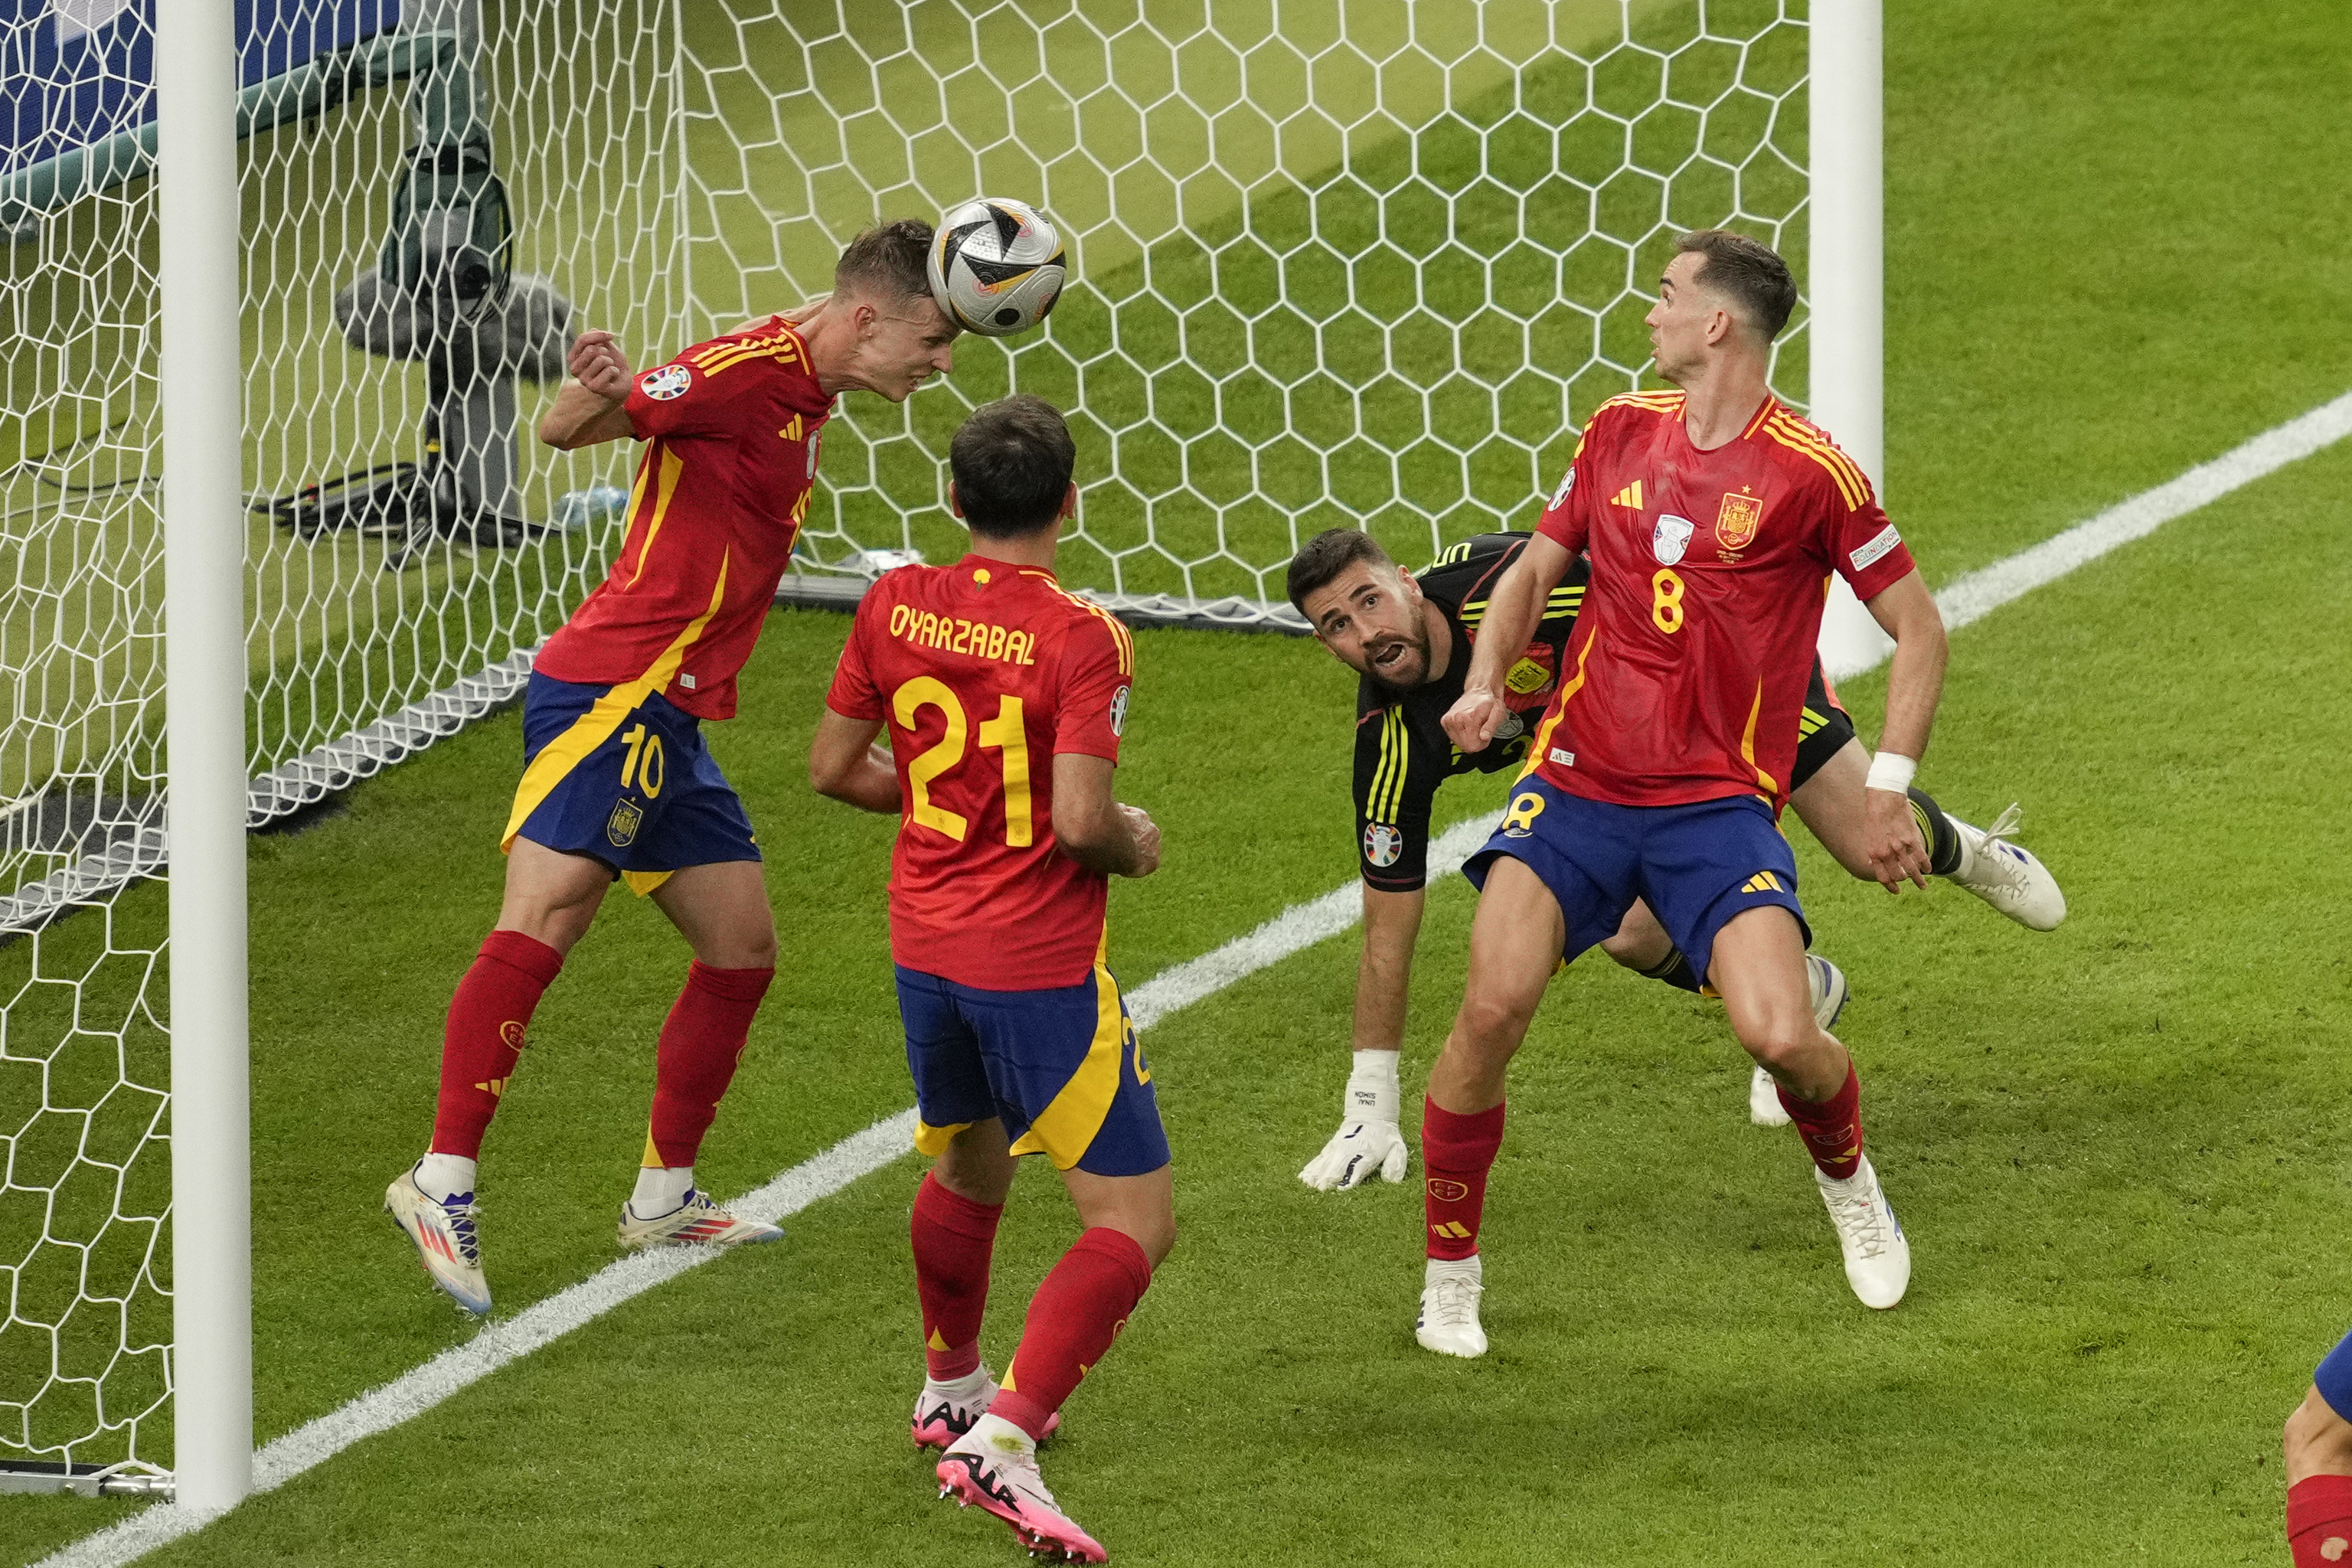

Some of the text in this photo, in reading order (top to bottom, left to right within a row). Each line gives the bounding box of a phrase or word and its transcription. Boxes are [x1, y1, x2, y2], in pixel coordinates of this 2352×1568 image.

[1854, 529, 1897, 564] FOUNDATION
[890, 604, 1035, 665] OYARZABAL
[1652, 568, 1685, 635] 8
[621, 724, 664, 799] 10
[892, 675, 1032, 847] 21
